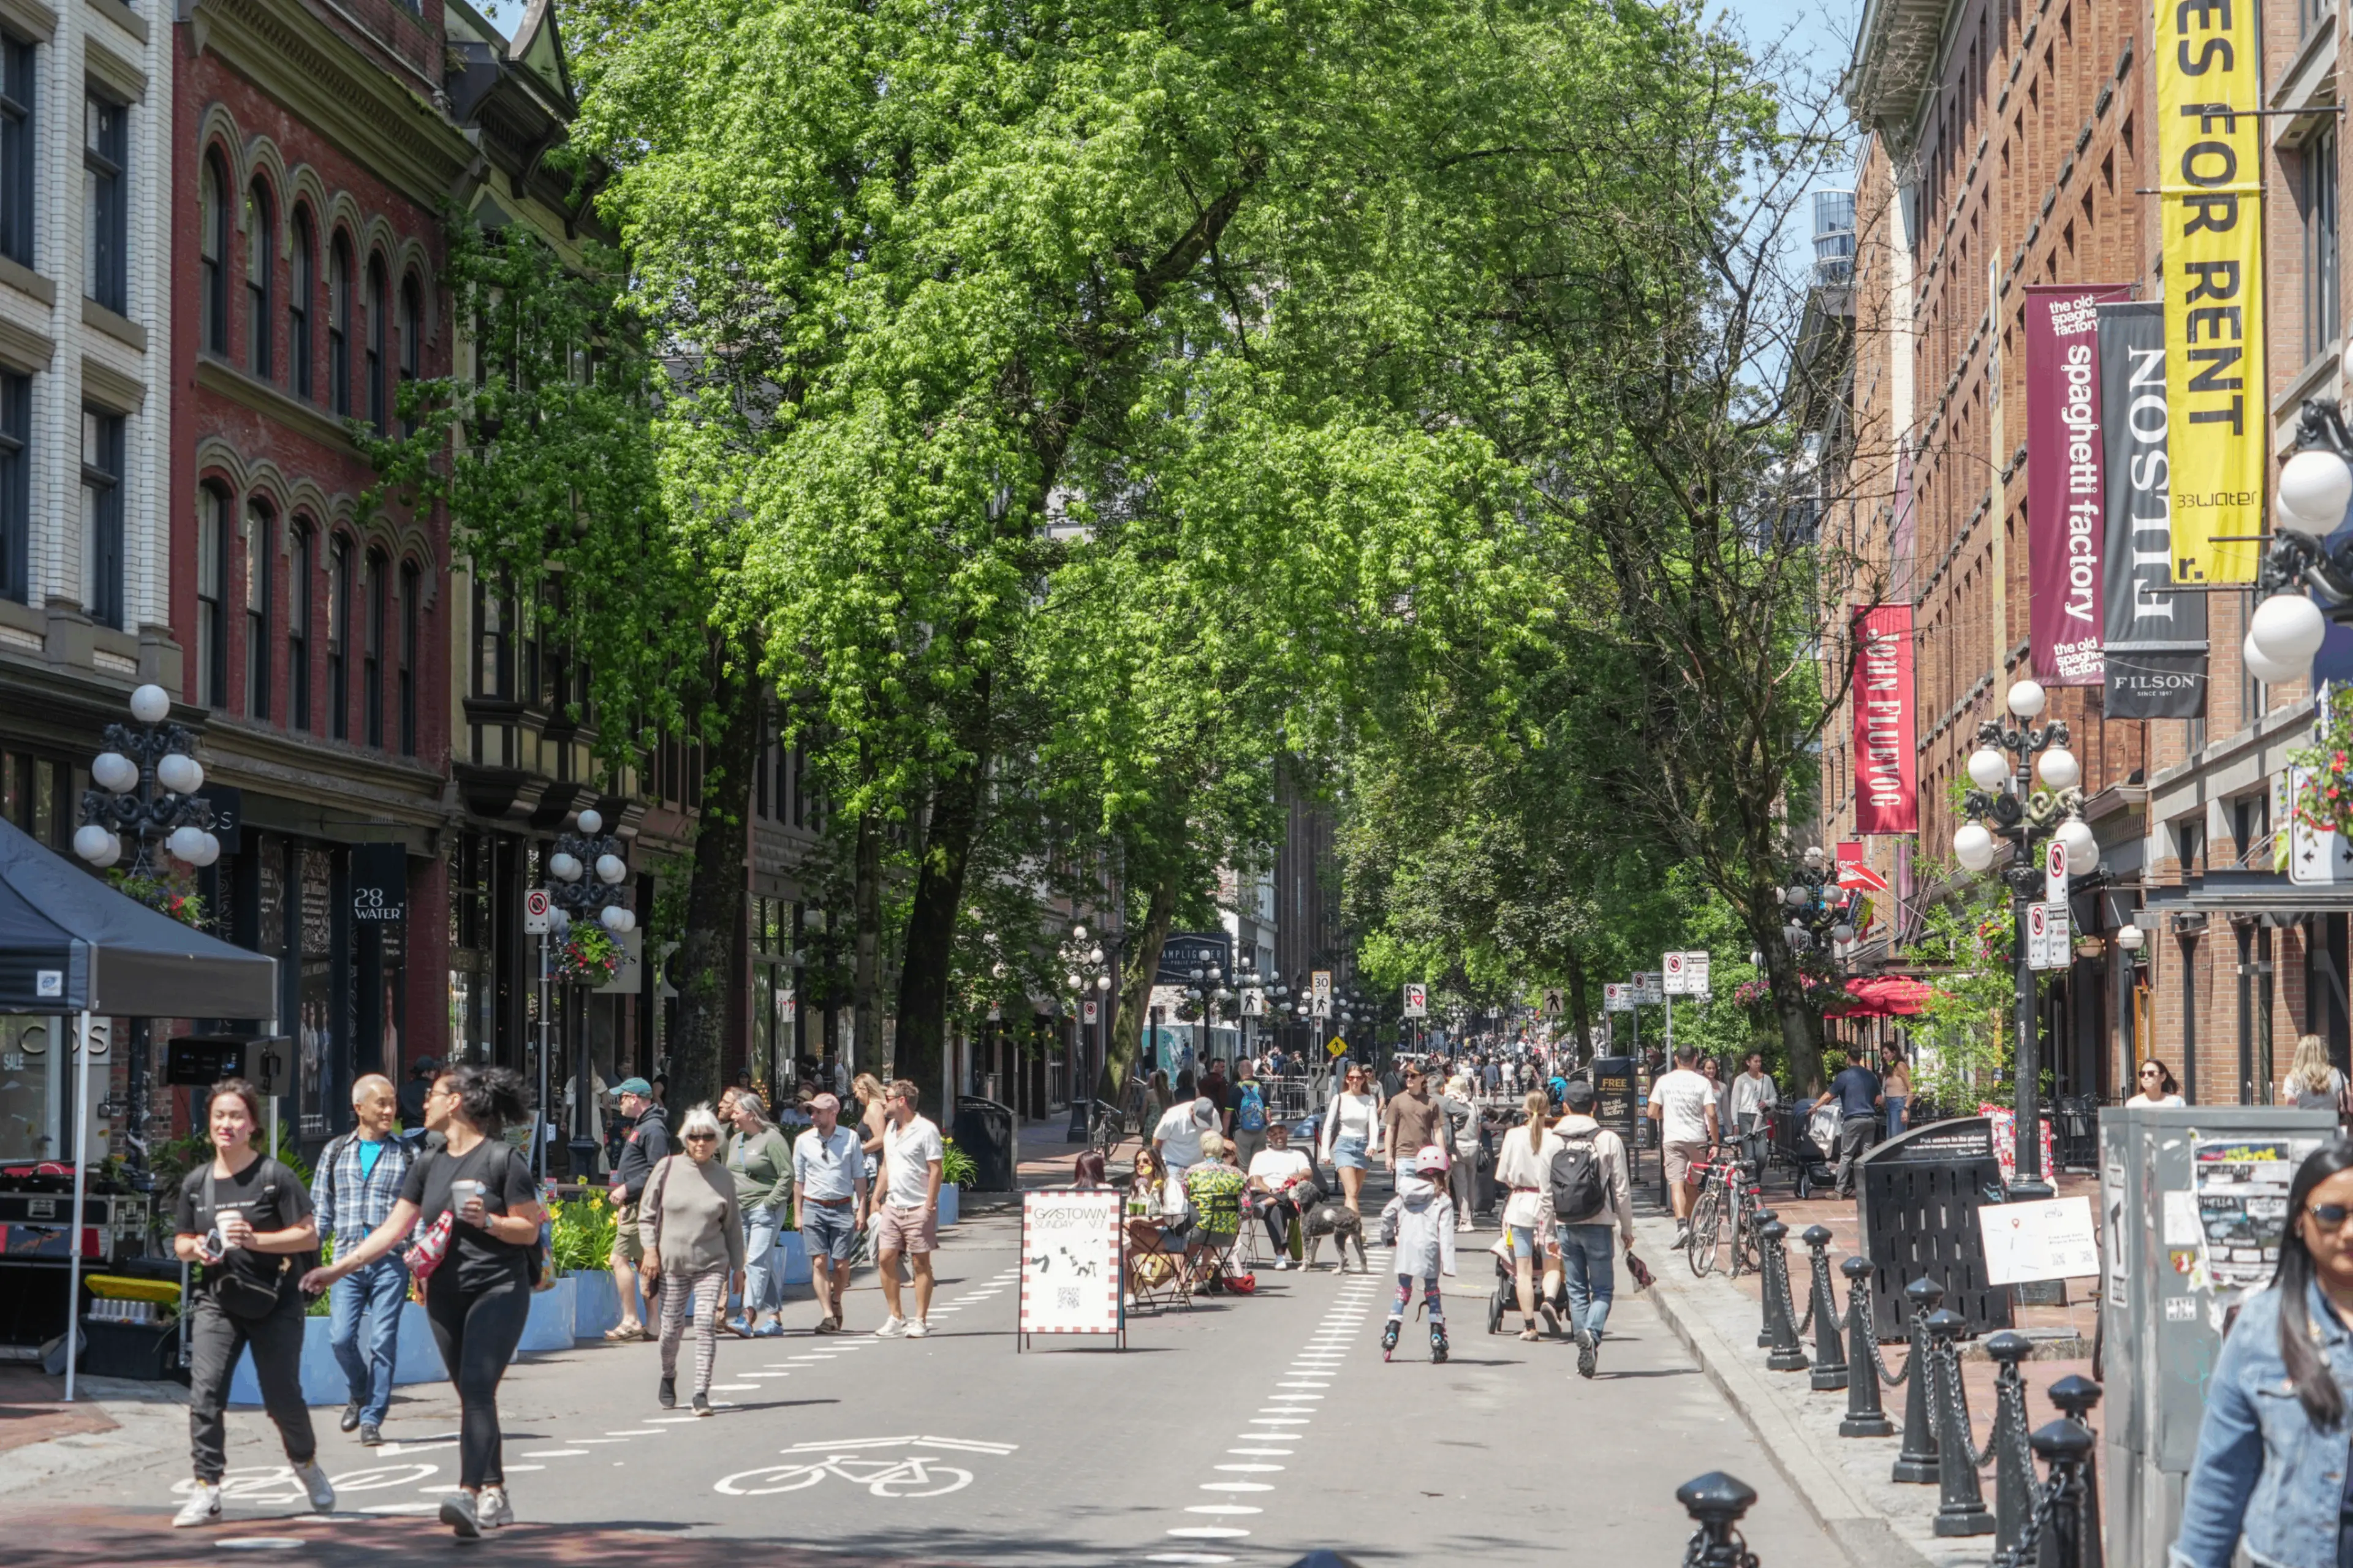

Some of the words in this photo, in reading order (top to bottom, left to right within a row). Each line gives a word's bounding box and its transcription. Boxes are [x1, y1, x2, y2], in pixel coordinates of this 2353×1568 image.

[2180, 103, 2239, 237] FOR
[2049, 301, 2071, 314] the
[2073, 294, 2094, 310] old
[2051, 306, 2097, 326] spaghe
[2053, 319, 2098, 337] factory
[2184, 260, 2244, 437] RENT
[2061, 344, 2099, 494] spaghetti
[2128, 345, 2175, 623] FILSON
[2064, 499, 2099, 623] factory
[2053, 643, 2075, 656] the
[2077, 636, 2098, 651] old
[1866, 629, 1900, 691] JOHN
[2059, 661, 2104, 678] factory
[2114, 675, 2196, 689] FILSON
[1867, 698, 1902, 808] FLUEVOG
[354, 888, 384, 908] 28
[354, 907, 401, 920] WATER
[1161, 950, 1222, 960] AMPLIGER
[1314, 977, 1328, 988] 30
[3, 1053, 25, 1071] SALE
[1602, 1078, 1627, 1088] FREE
